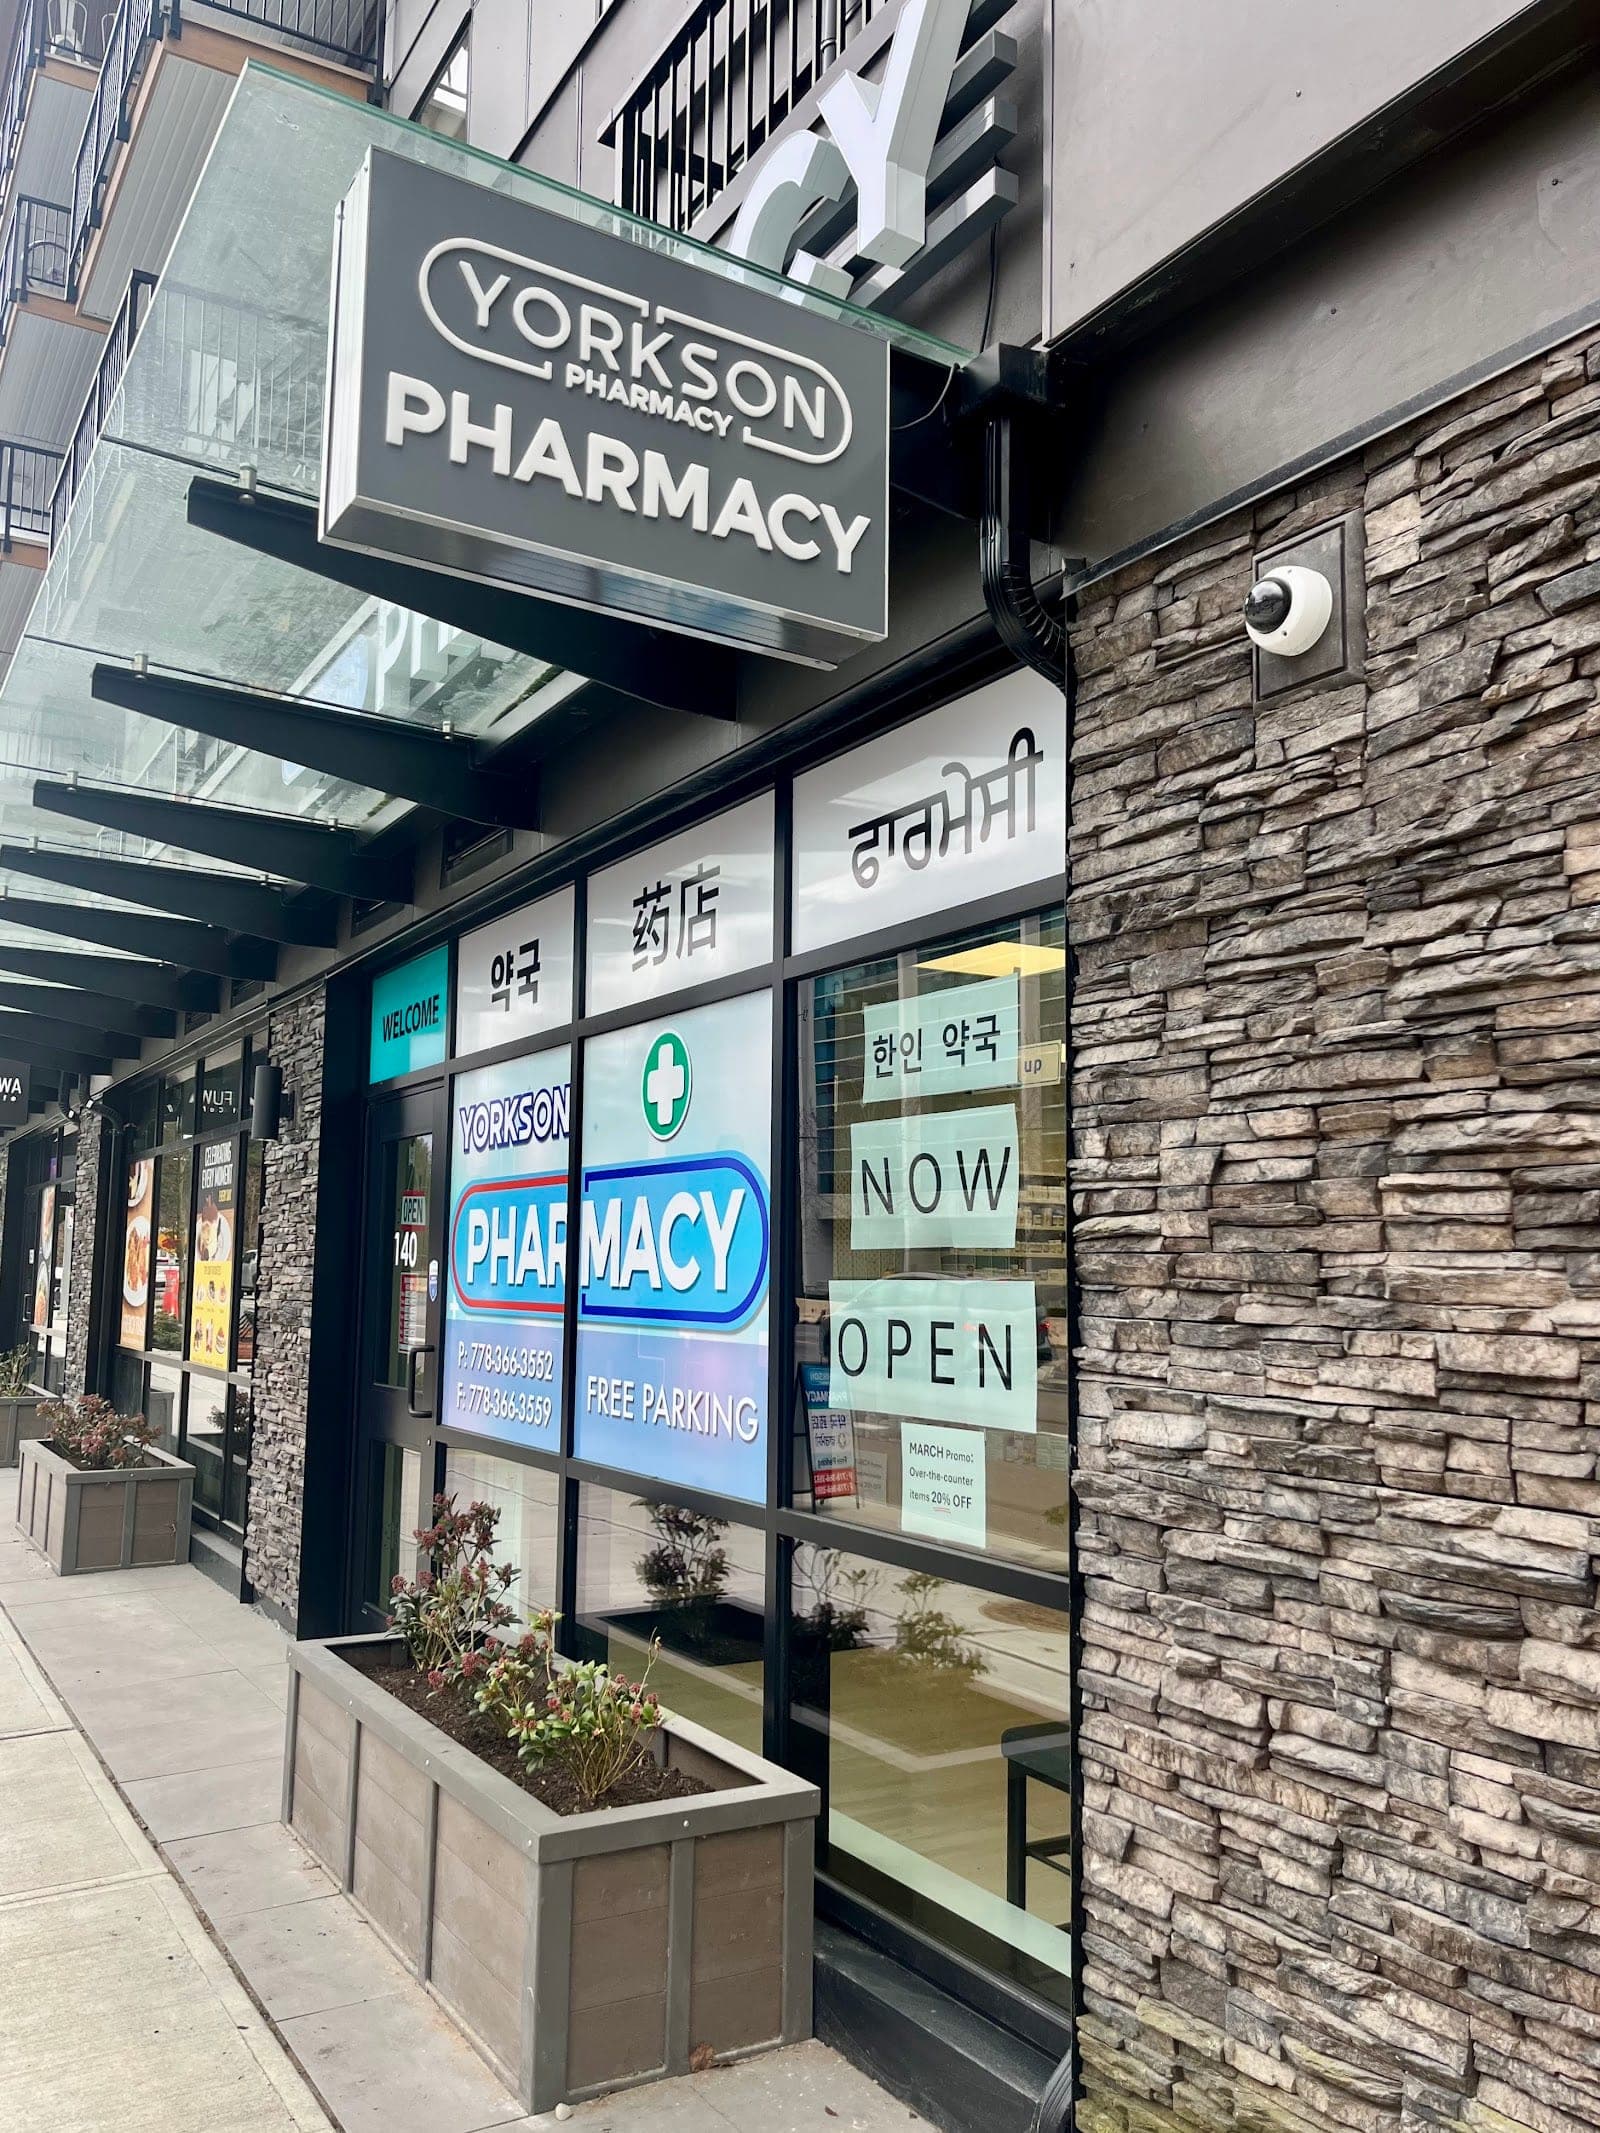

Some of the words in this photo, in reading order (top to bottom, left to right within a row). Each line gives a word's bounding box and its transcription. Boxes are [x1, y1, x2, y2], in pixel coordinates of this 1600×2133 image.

[458, 259, 827, 440] YORKSON
[564, 361, 733, 438] PHARMACY
[384, 369, 872, 575] PHARMACY
[631, 862, 721, 973] 药店
[490, 938, 541, 1013] 약국
[382, 994, 440, 1042] WELCOME
[872, 1027, 922, 1078] 한인
[942, 1014, 1001, 1067] 약국
[459, 1083, 571, 1154] YORKSON
[402, 1198, 424, 1224] OPEN
[860, 1146, 1011, 1216] NOW
[394, 1231, 418, 1268] 140
[466, 1188, 746, 1293] PHARMACY
[458, 1340, 468, 1369] P:
[470, 1342, 554, 1382] 778-366-3552
[837, 1317, 1013, 1391] OPEN
[456, 1382, 466, 1409] F:
[468, 1384, 552, 1428] 778-366-3559
[586, 1375, 635, 1420] FREE
[642, 1383, 759, 1442] PARKING
[909, 1442, 944, 1459] MARCH
[945, 1449, 974, 1463] Promo:
[909, 1466, 974, 1486] Over-the-counter
[909, 1488, 930, 1502] items
[931, 1490, 951, 1506] 20%
[952, 1494, 972, 1509] OFF
